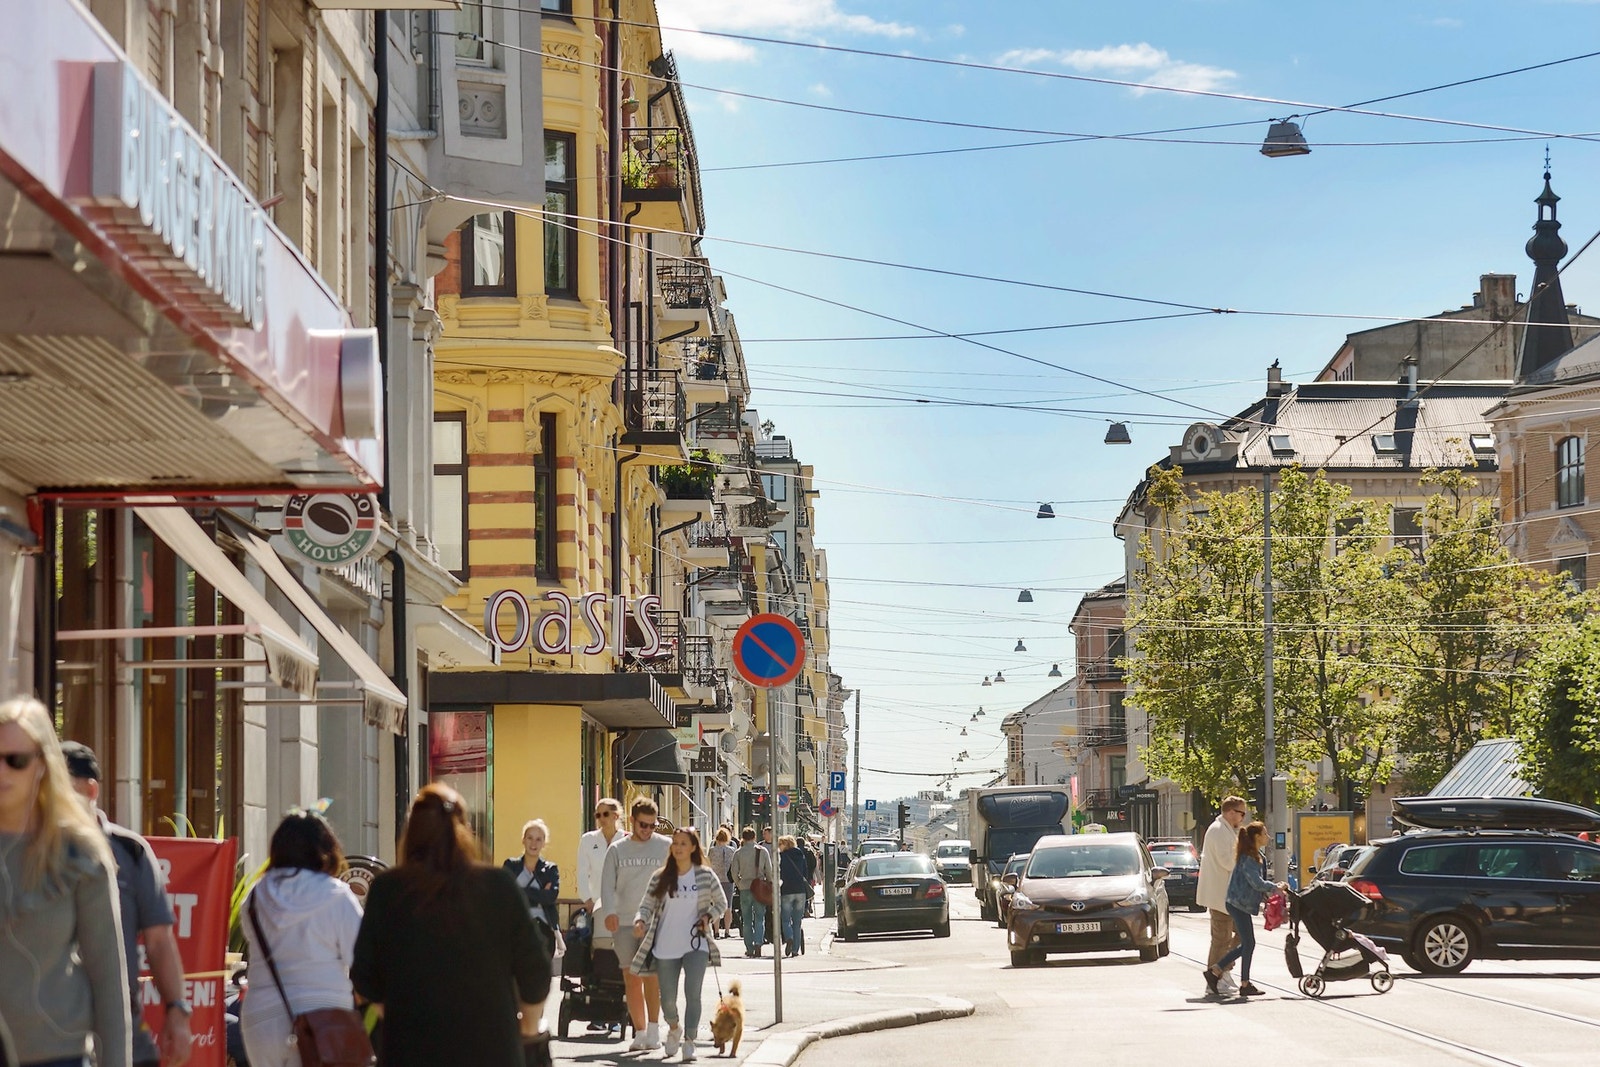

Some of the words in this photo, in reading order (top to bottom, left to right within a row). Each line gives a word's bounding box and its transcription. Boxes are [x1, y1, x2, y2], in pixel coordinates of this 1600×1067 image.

[297, 537, 361, 561] HOUSE
[834, 774, 842, 788] P
[1106, 810, 1118, 820] ARK
